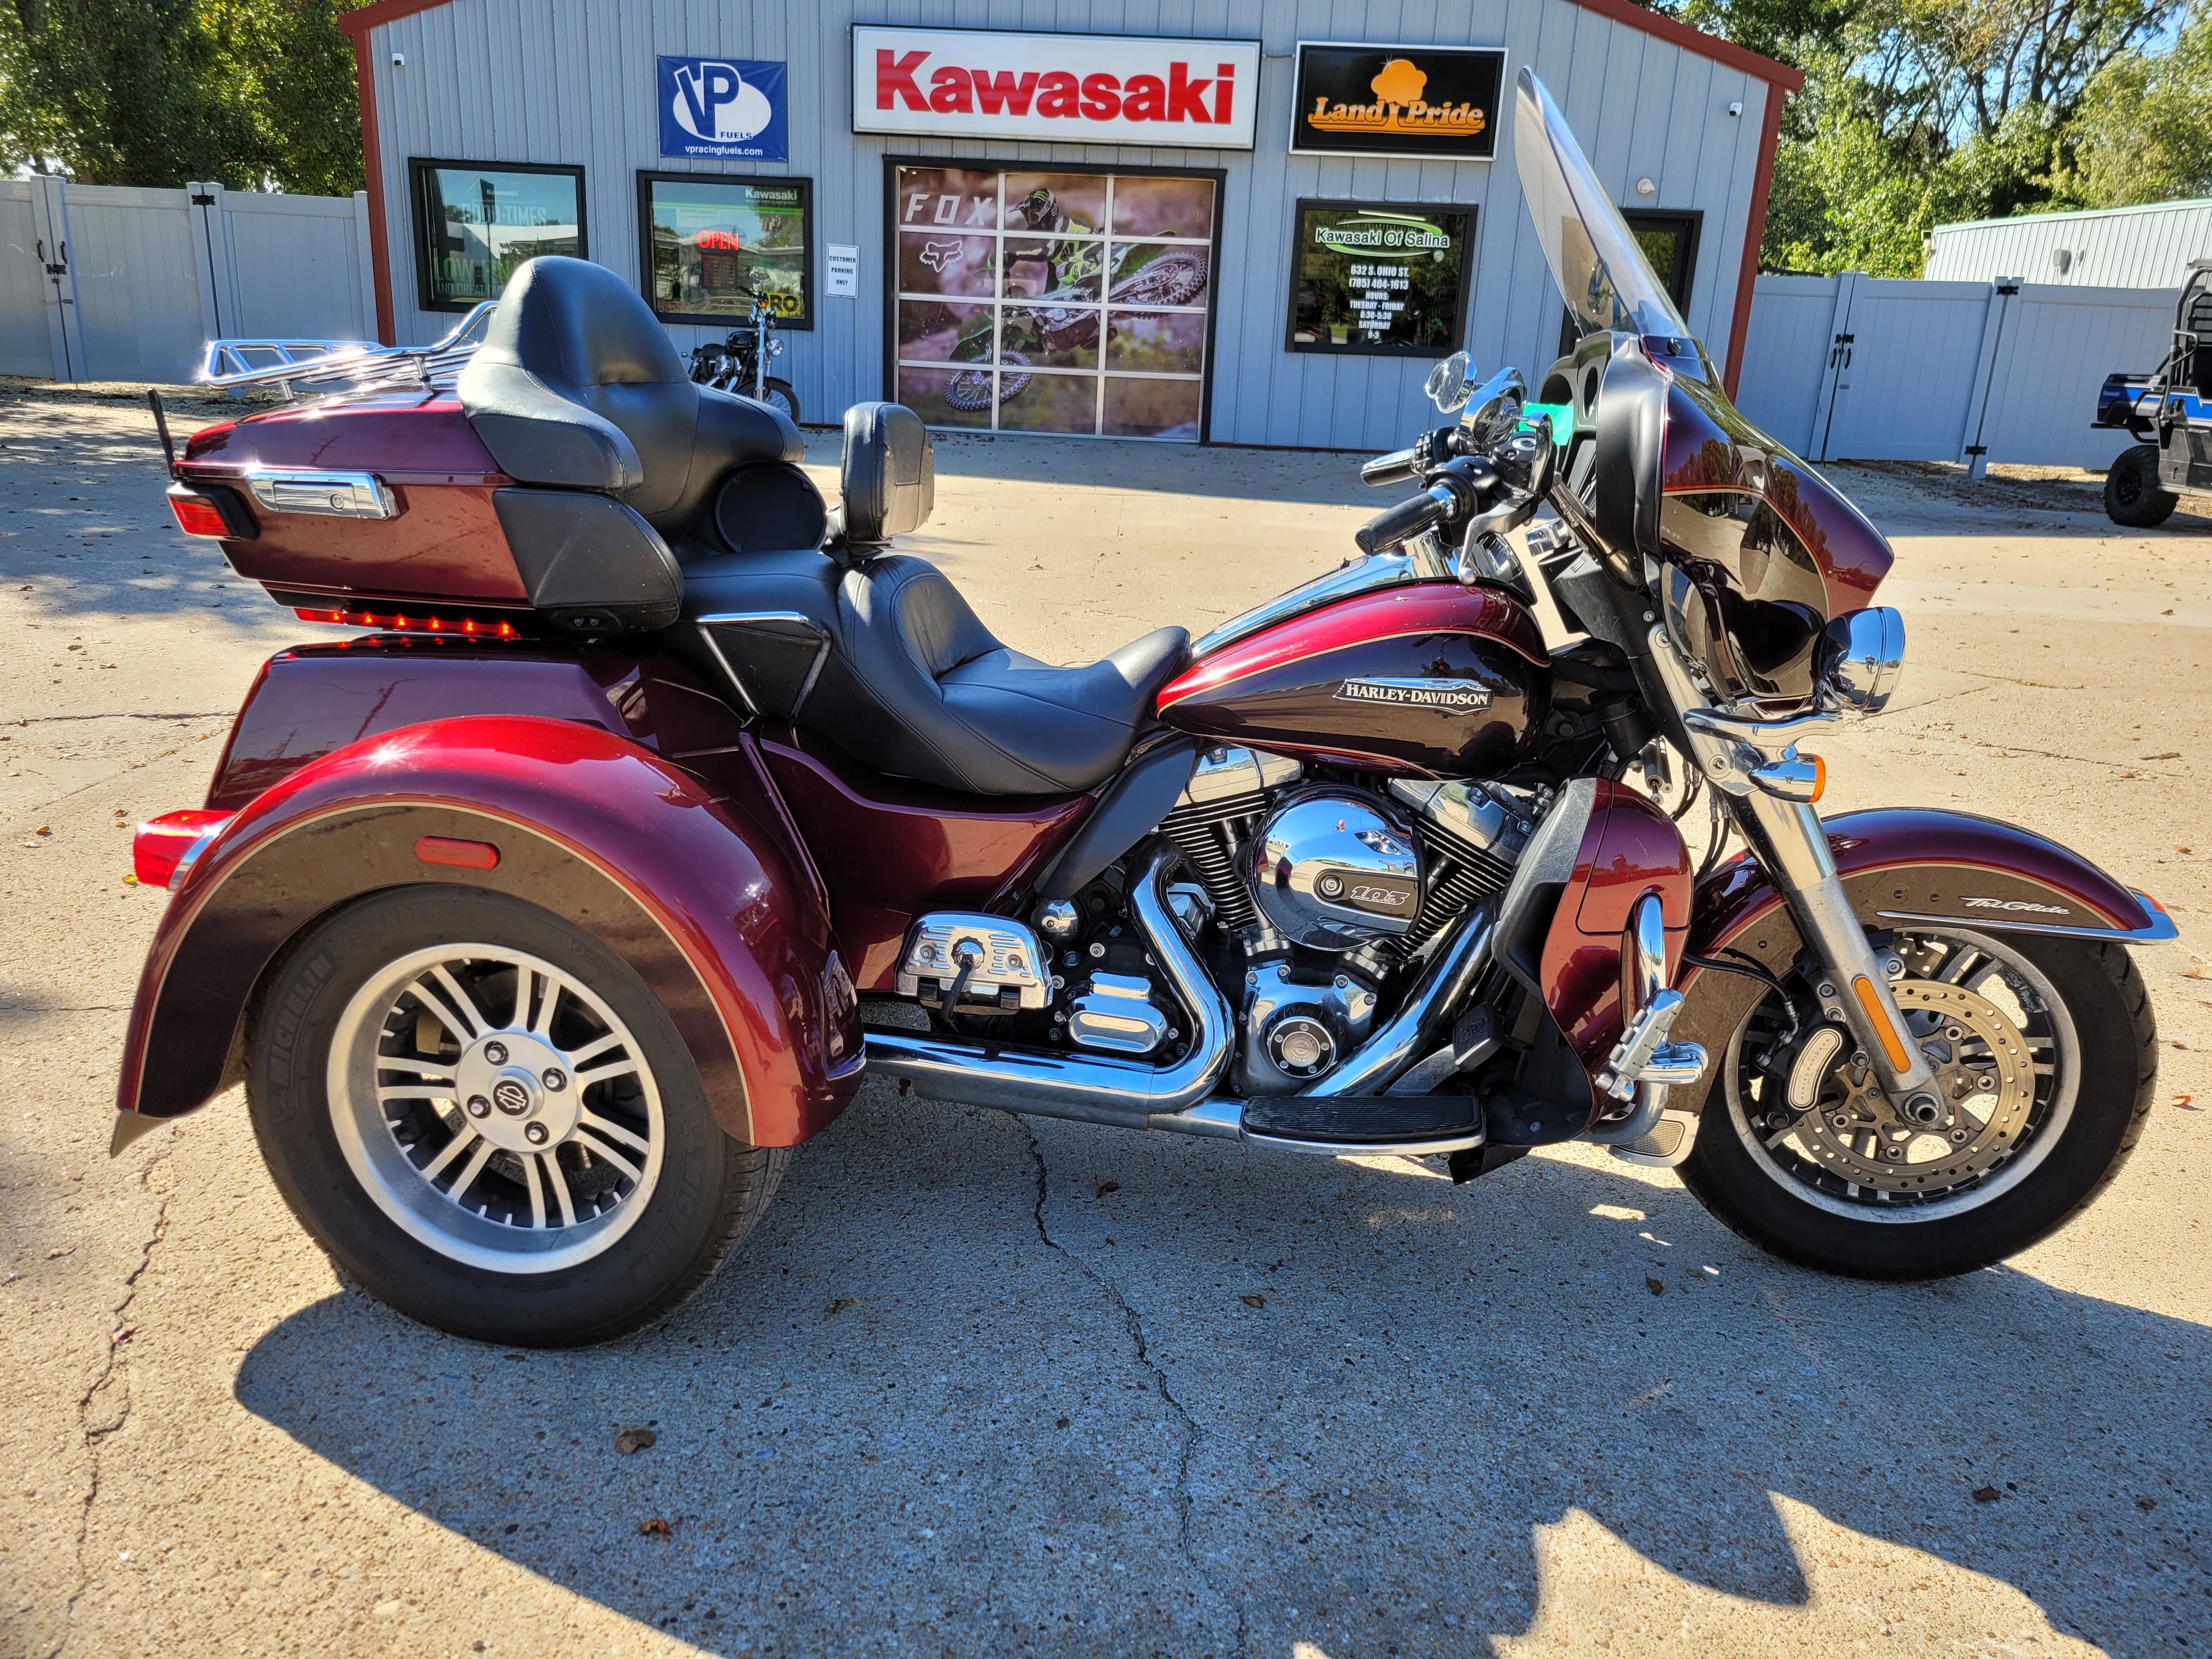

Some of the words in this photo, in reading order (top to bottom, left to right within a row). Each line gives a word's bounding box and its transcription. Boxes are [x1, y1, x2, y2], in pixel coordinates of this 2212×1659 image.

[876, 49, 1235, 125] Kawasaki
[674, 63, 742, 139] VP
[1312, 97, 1386, 123] Land
[1403, 100, 1484, 127] Pride
[720, 131, 753, 140] FUELS
[685, 145, 763, 156] vpracingfuels.com
[746, 188, 797, 201] Kawasaki
[905, 193, 993, 226] FOX
[697, 229, 739, 251] OPEN
[1316, 227, 1382, 245] Kawasaki
[1384, 230, 1403, 246] Of
[1406, 232, 1450, 248] Salina
[1350, 264, 1367, 275] 632
[1377, 266, 1397, 277] OHIO
[1398, 267, 1409, 278] ST.
[436, 283, 454, 295] AND
[457, 284, 484, 296] GREAT
[1348, 278, 1370, 289] (785)
[1371, 279, 1409, 290] 404-1613
[1365, 291, 1390, 301] HOURS:
[1350, 301, 1378, 309] TUESDAY
[1381, 303, 1405, 312] FRIDAY
[1358, 320, 1391, 330] SATURDAY
[1346, 682, 1488, 706] HARLEY-DAVIDSON
[1350, 885, 1411, 905] 103
[268, 951, 332, 1089] MICHELIN
[1801, 1038, 1831, 1100] HARLEY-DAVIDSON
